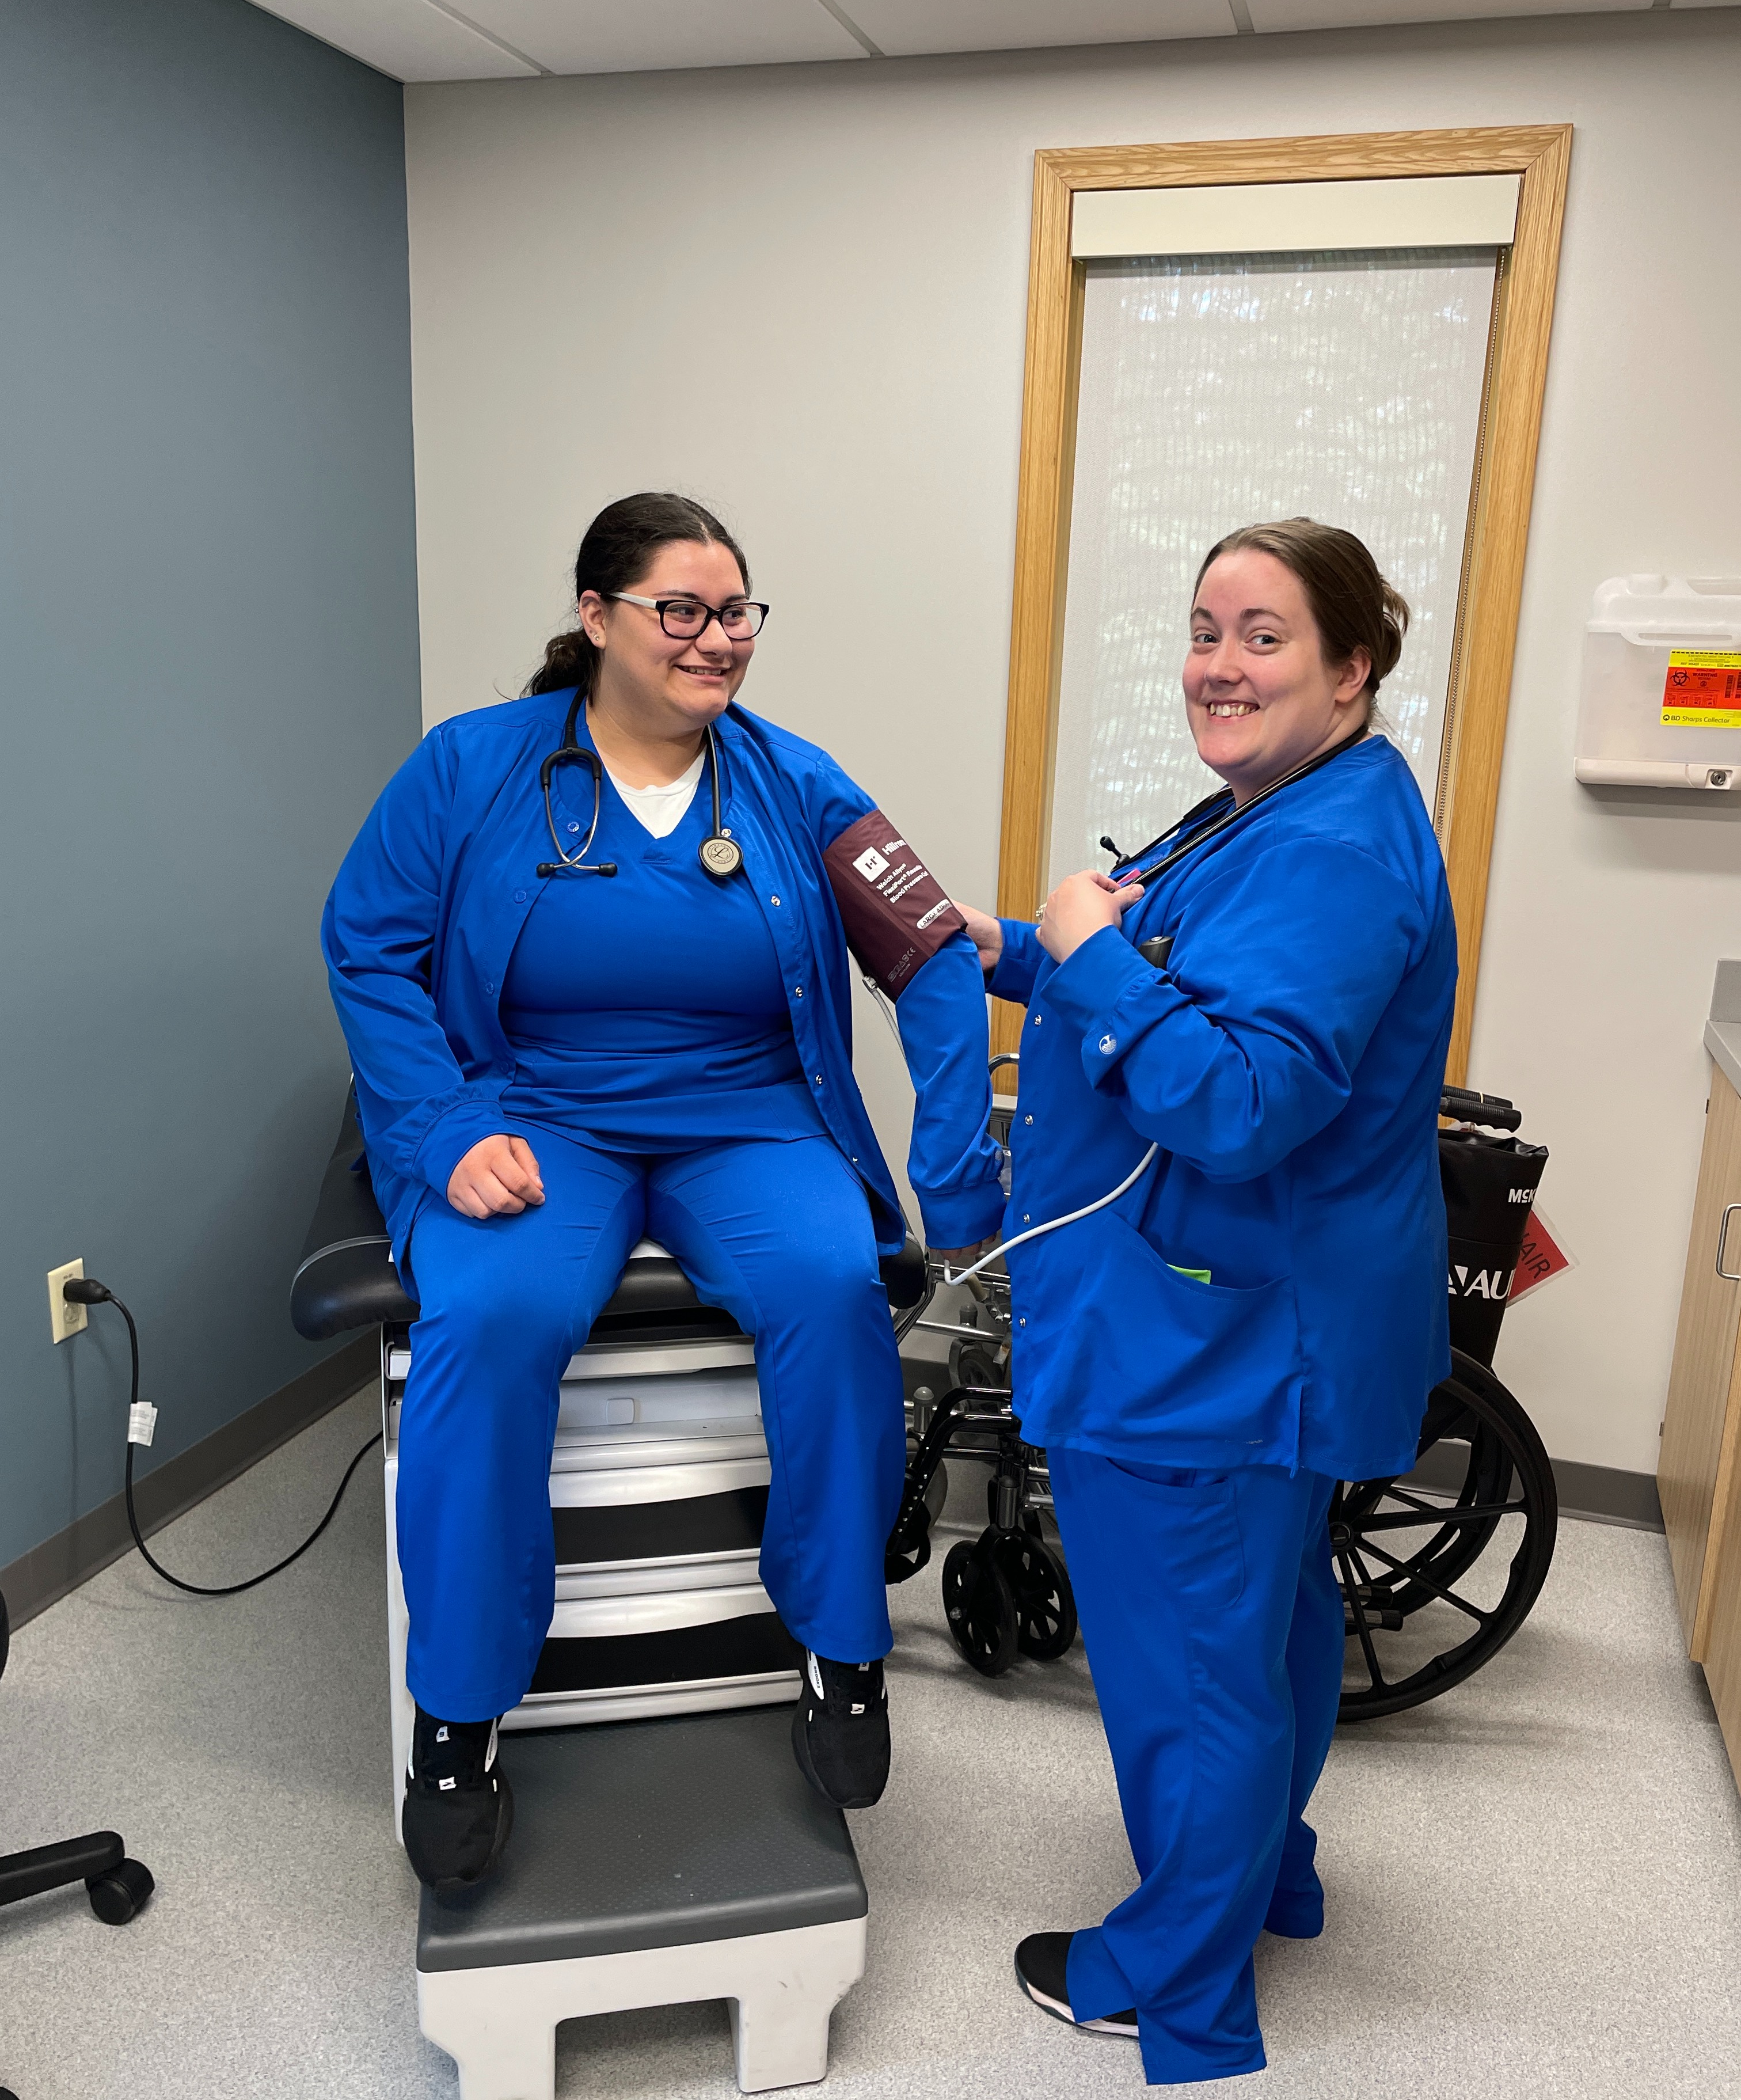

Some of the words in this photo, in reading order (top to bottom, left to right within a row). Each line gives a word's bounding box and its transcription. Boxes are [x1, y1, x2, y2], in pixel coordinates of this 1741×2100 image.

[876, 874, 894, 891] Welch
[889, 888, 906, 904] Blood
[919, 911, 938, 928] LARGE
[1463, 1268, 1516, 1300] AU
